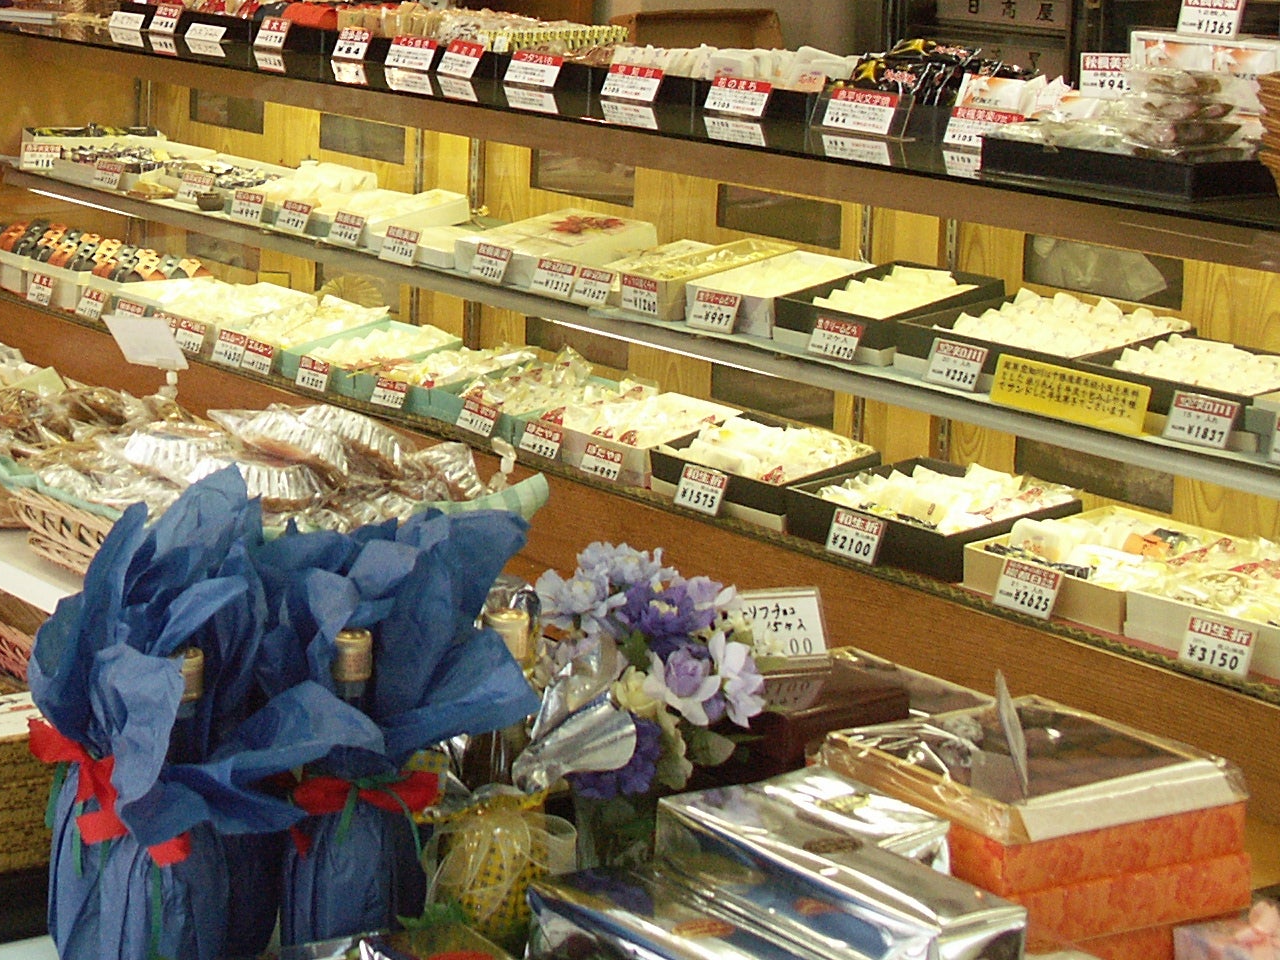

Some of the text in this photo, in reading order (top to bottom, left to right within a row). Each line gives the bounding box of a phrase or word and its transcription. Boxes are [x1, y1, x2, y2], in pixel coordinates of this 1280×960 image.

[1197, 19, 1232, 35] ¥1365
[338, 45, 361, 55] ¥84
[704, 310, 731, 326] ¥997
[938, 342, 983, 362] 空知川
[1180, 396, 1232, 417] 空知川
[1187, 424, 1225, 443] ¥1837
[681, 487, 715, 509] ¥1575
[831, 534, 871, 557] ¥2100
[1013, 591, 1050, 613] ¥2625
[1191, 617, 1251, 646] 和生折
[1187, 644, 1239, 671] ¥3150
